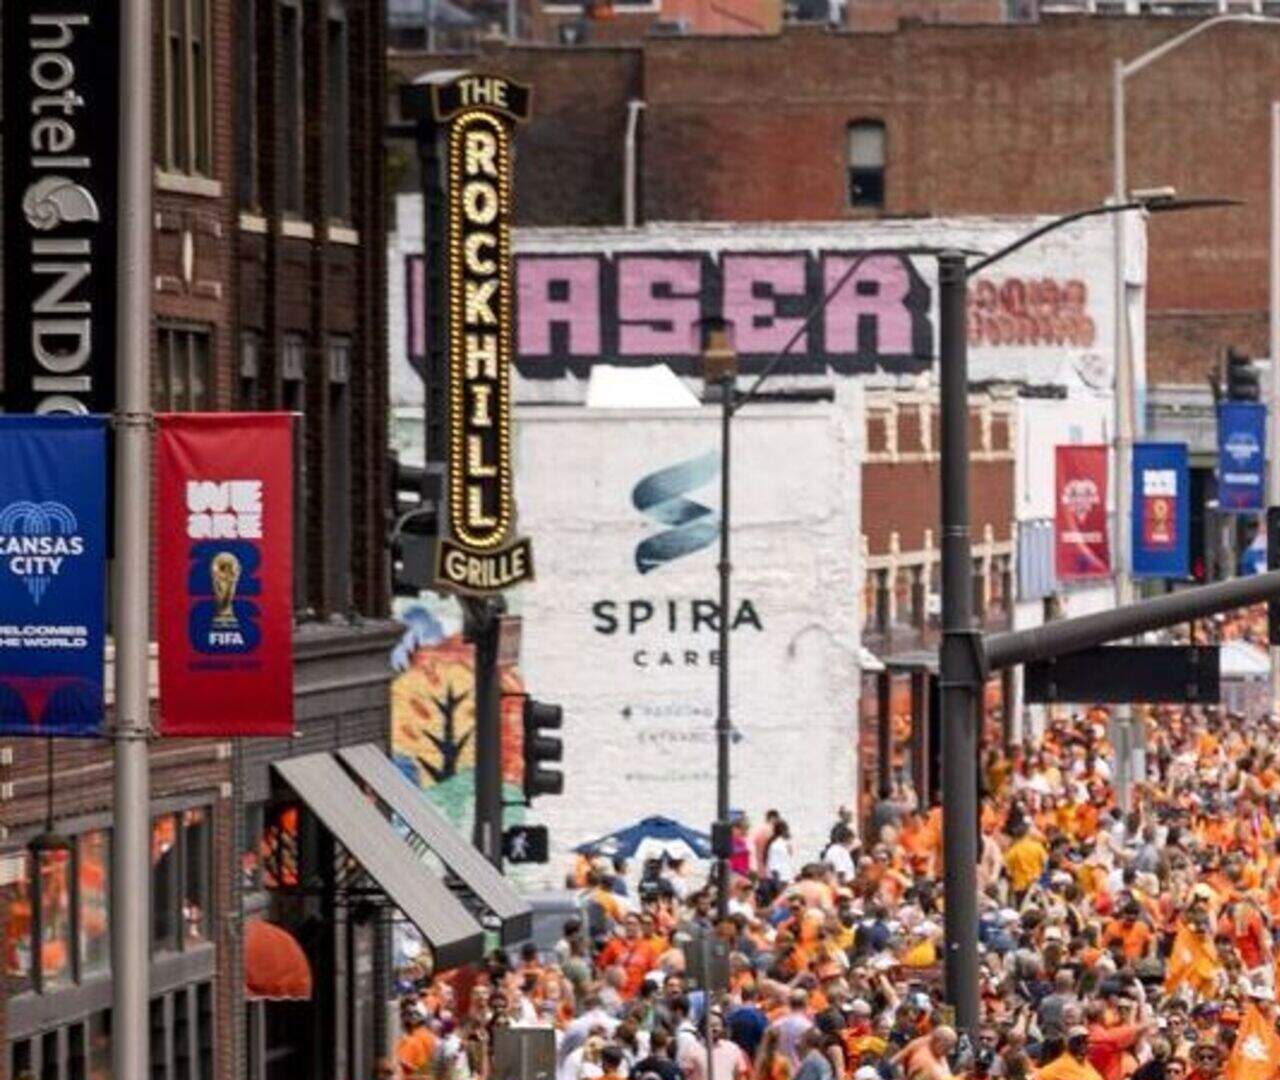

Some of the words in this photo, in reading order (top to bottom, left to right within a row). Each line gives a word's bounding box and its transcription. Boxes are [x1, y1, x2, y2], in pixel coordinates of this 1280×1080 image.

[29, 14, 91, 168] hotel
[458, 79, 509, 106] THE
[400, 250, 925, 372] ASER
[463, 131, 498, 528] ROCKHILL
[9, 556, 63, 575] CITY
[444, 548, 527, 584] GRILLE
[591, 599, 763, 635] SPIRA
[208, 632, 244, 646] FIFA
[632, 649, 720, 668] CARE
